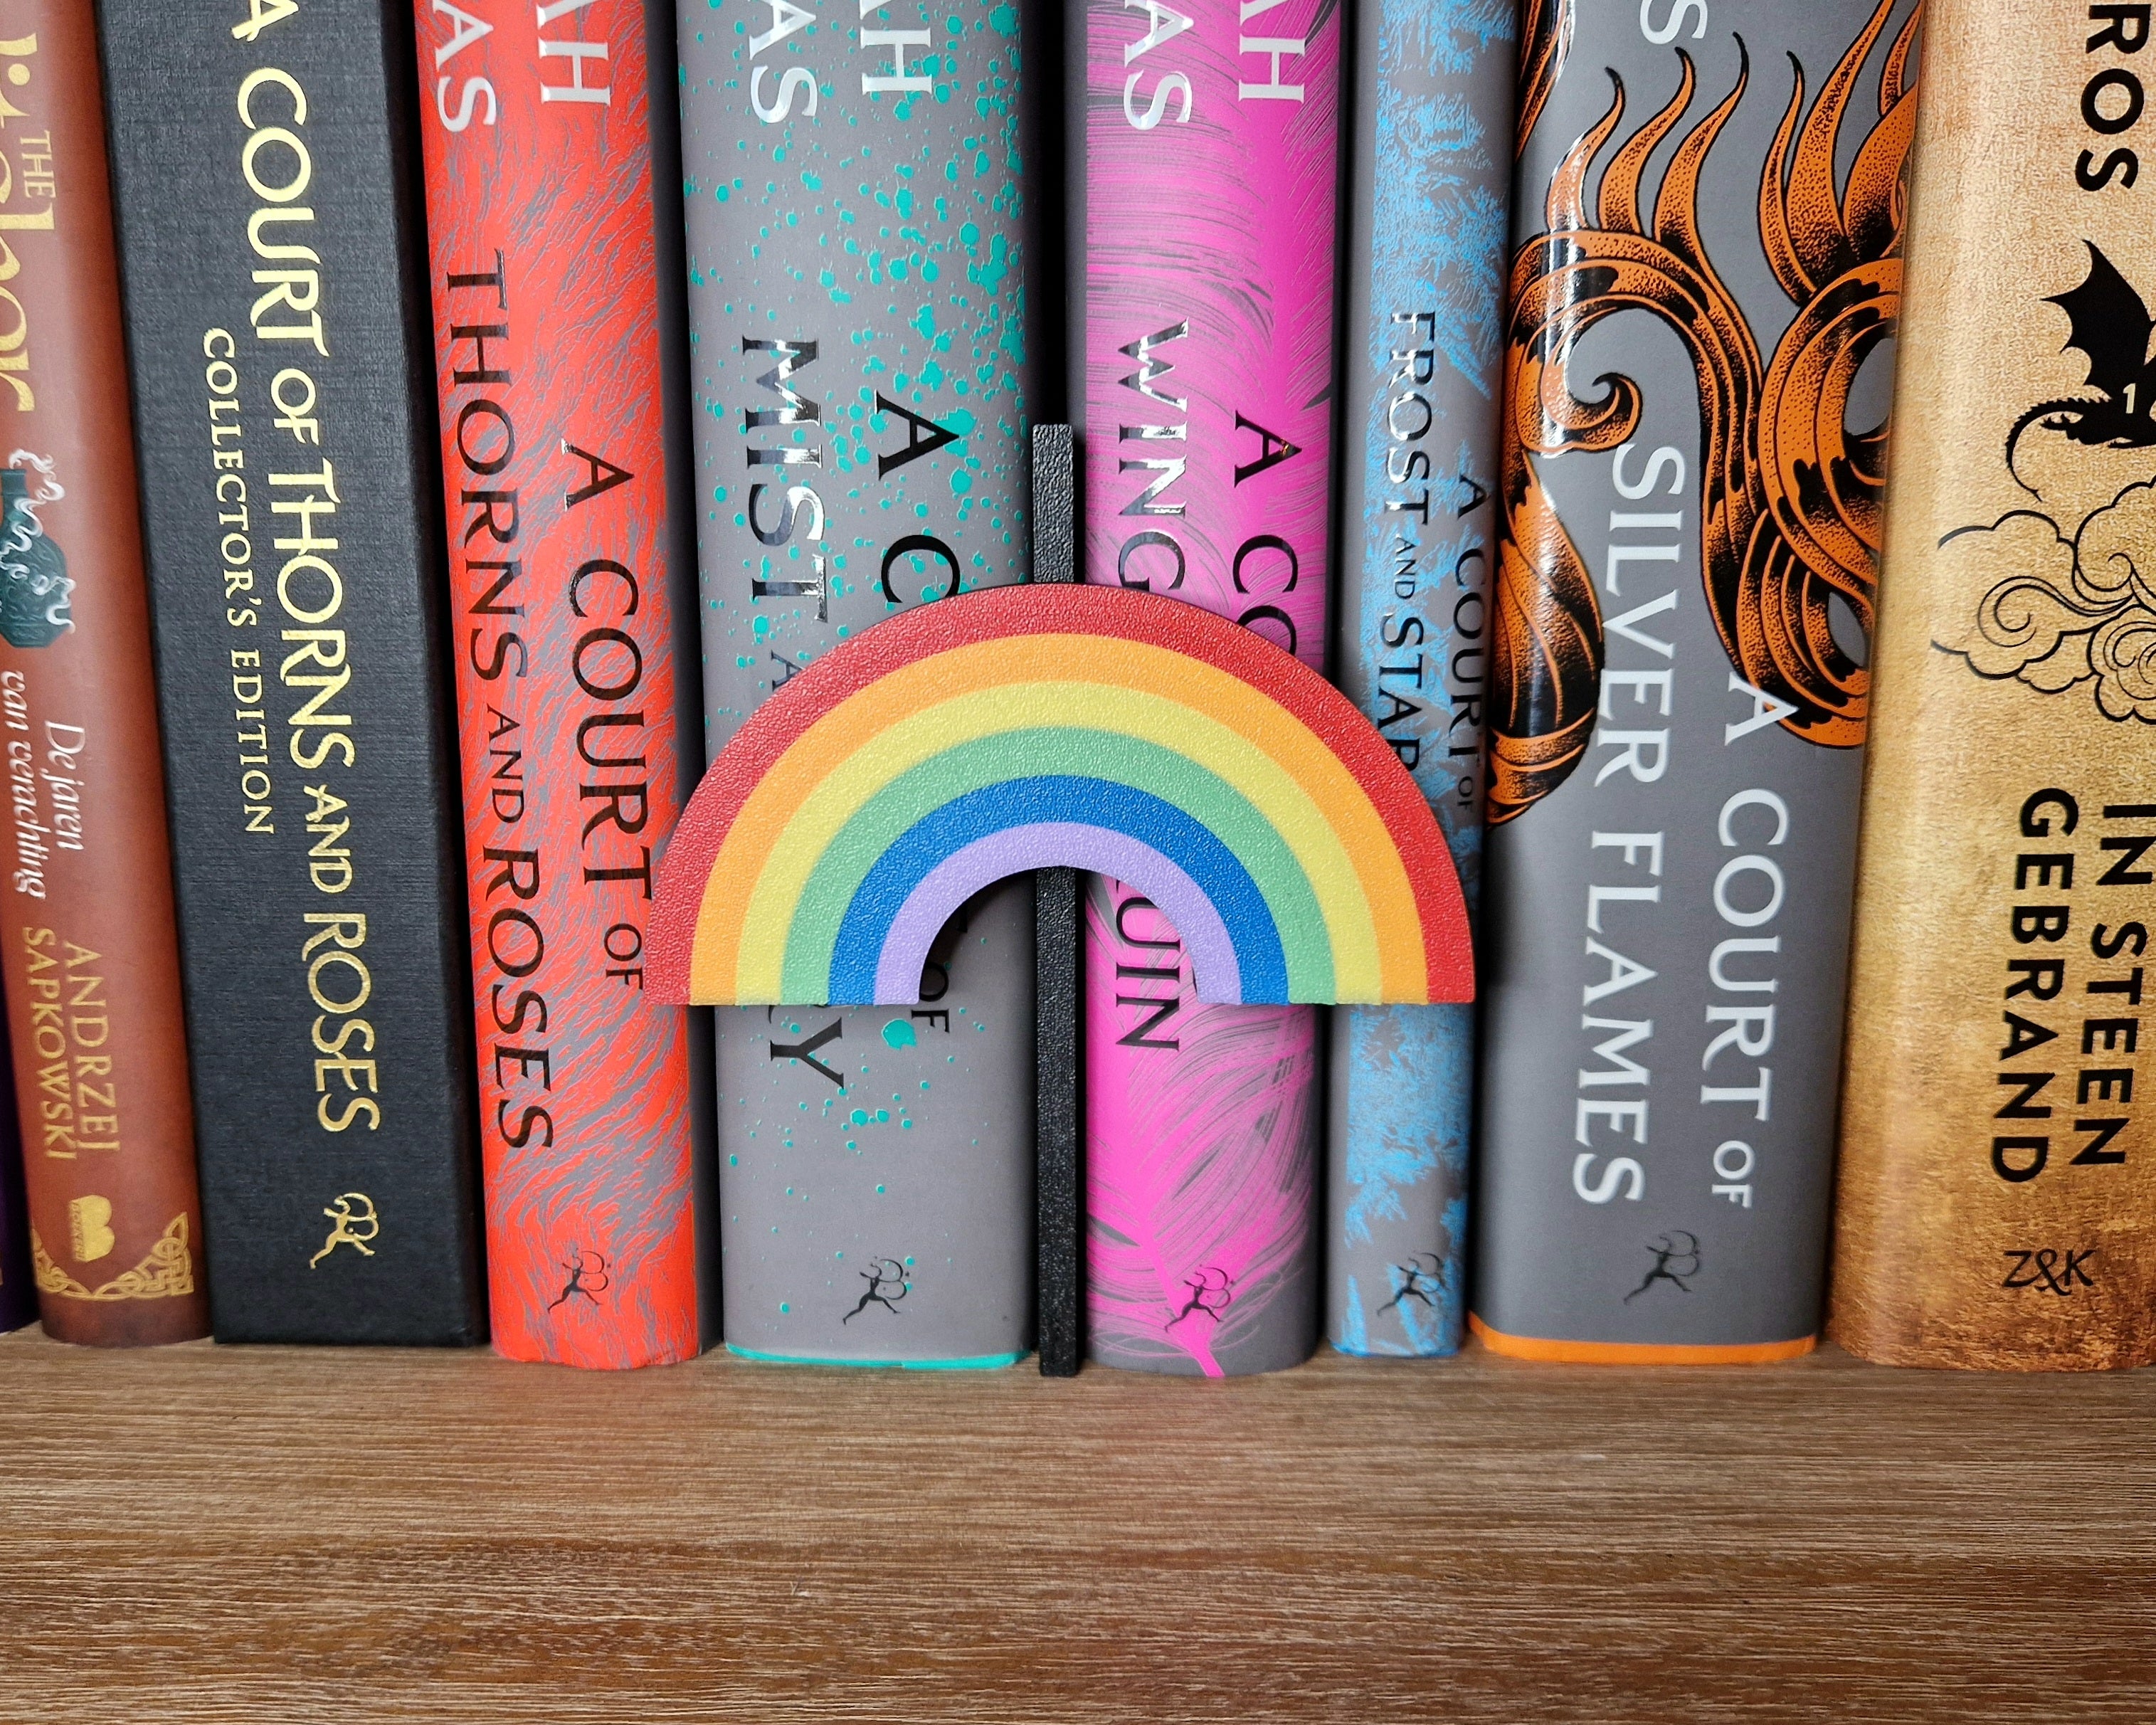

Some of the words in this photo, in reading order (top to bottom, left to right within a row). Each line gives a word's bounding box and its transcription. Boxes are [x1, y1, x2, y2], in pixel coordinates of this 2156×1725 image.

[20, 131, 56, 198] THE
[2074, 4, 2151, 191] ROS
[237, 67, 329, 357] COURT
[203, 327, 264, 628] COLLECTOR'S
[270, 368, 319, 445] OF
[447, 248, 528, 681] THORNS
[561, 438, 635, 512] A
[742, 334, 828, 623] MIST
[874, 389, 960, 481] A
[1118, 317, 1188, 594] WING
[1235, 410, 1303, 487] A
[1384, 311, 1435, 525] FROST
[1395, 534, 1415, 600] AND
[1457, 475, 1488, 520] A
[268, 458, 354, 770] THORNS
[1378, 612, 1424, 771] STAR
[1449, 548, 1487, 766] COURT
[1595, 444, 1685, 787] SILVER
[1, 670, 28, 731] van
[45, 720, 85, 770] De
[231, 648, 275, 834] EDITION
[487, 702, 525, 824] AND
[569, 559, 652, 900] COURT
[1724, 670, 1799, 746] A
[8, 741, 51, 899] verachting
[39, 768, 85, 850] jaren
[303, 784, 353, 893] AND
[1457, 776, 1474, 811] OF
[2096, 804, 2156, 885] IN
[302, 913, 380, 1132] ROSES
[483, 845, 554, 1149] ROSES
[603, 922, 643, 991] OF
[1116, 880, 1181, 1051] UIN
[1573, 830, 1664, 1204] FLAMES
[1700, 788, 1790, 1121] COURT
[1992, 788, 2079, 1182] GEBRAND
[22, 927, 77, 1159] SAPKOWSKI
[64, 941, 120, 1151] ANDRZEJ
[2070, 922, 2147, 1165] STEEN
[1711, 1139, 1755, 1208] OF
[2002, 1249, 2096, 1295] Z&K
